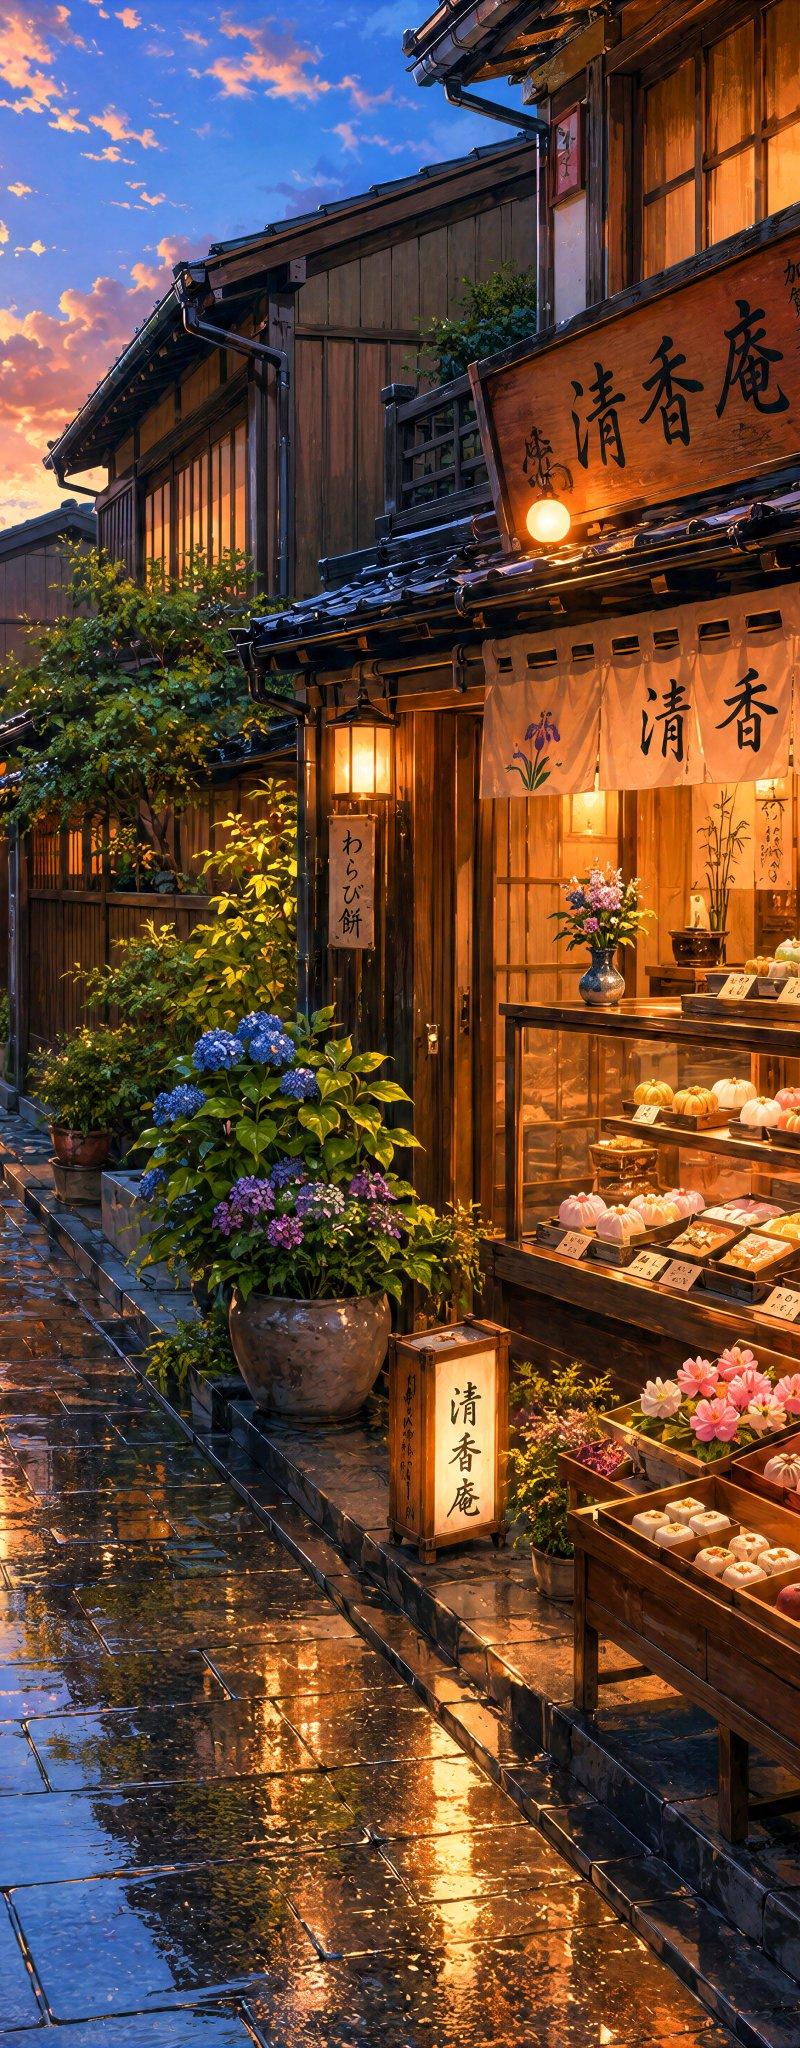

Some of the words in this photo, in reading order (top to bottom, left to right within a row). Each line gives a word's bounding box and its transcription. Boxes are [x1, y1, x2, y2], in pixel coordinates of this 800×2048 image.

[571, 300, 790, 469] 清香庵
[641, 668, 778, 763] 清香
[338, 830, 364, 938] わらび餅
[447, 1382, 482, 1518] 清香庵
